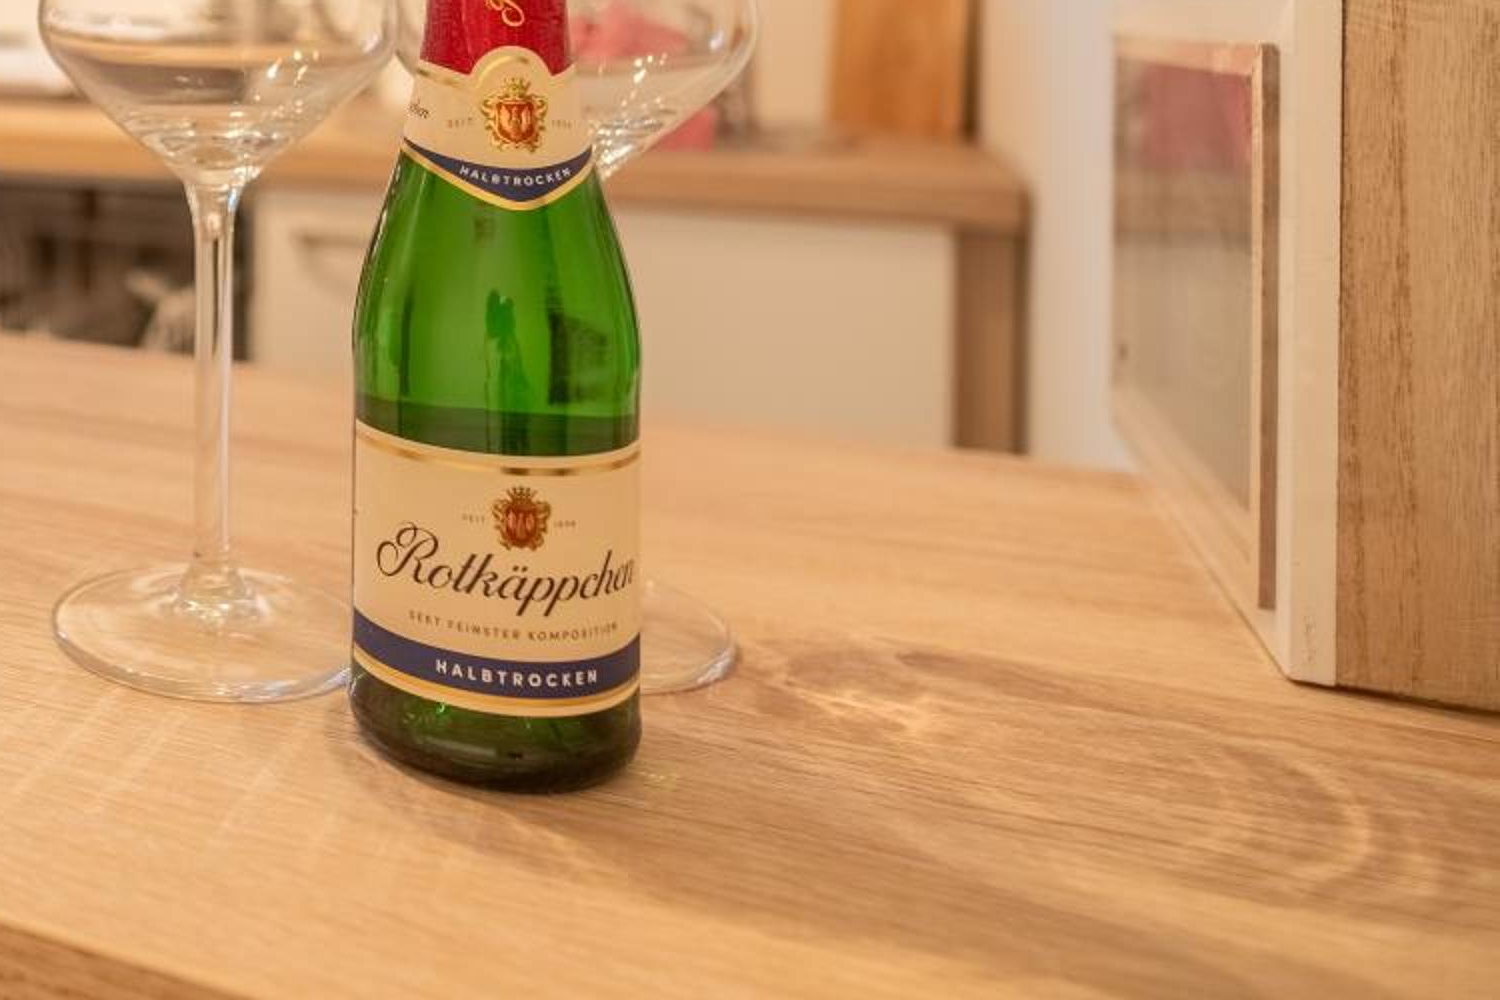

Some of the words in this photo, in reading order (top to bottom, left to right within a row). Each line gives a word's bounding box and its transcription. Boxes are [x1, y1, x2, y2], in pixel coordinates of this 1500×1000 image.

[459, 164, 572, 187] HALBTROCKEN
[377, 522, 635, 616] Rotkäppchen
[435, 658, 598, 688] HALBTROCKEN
